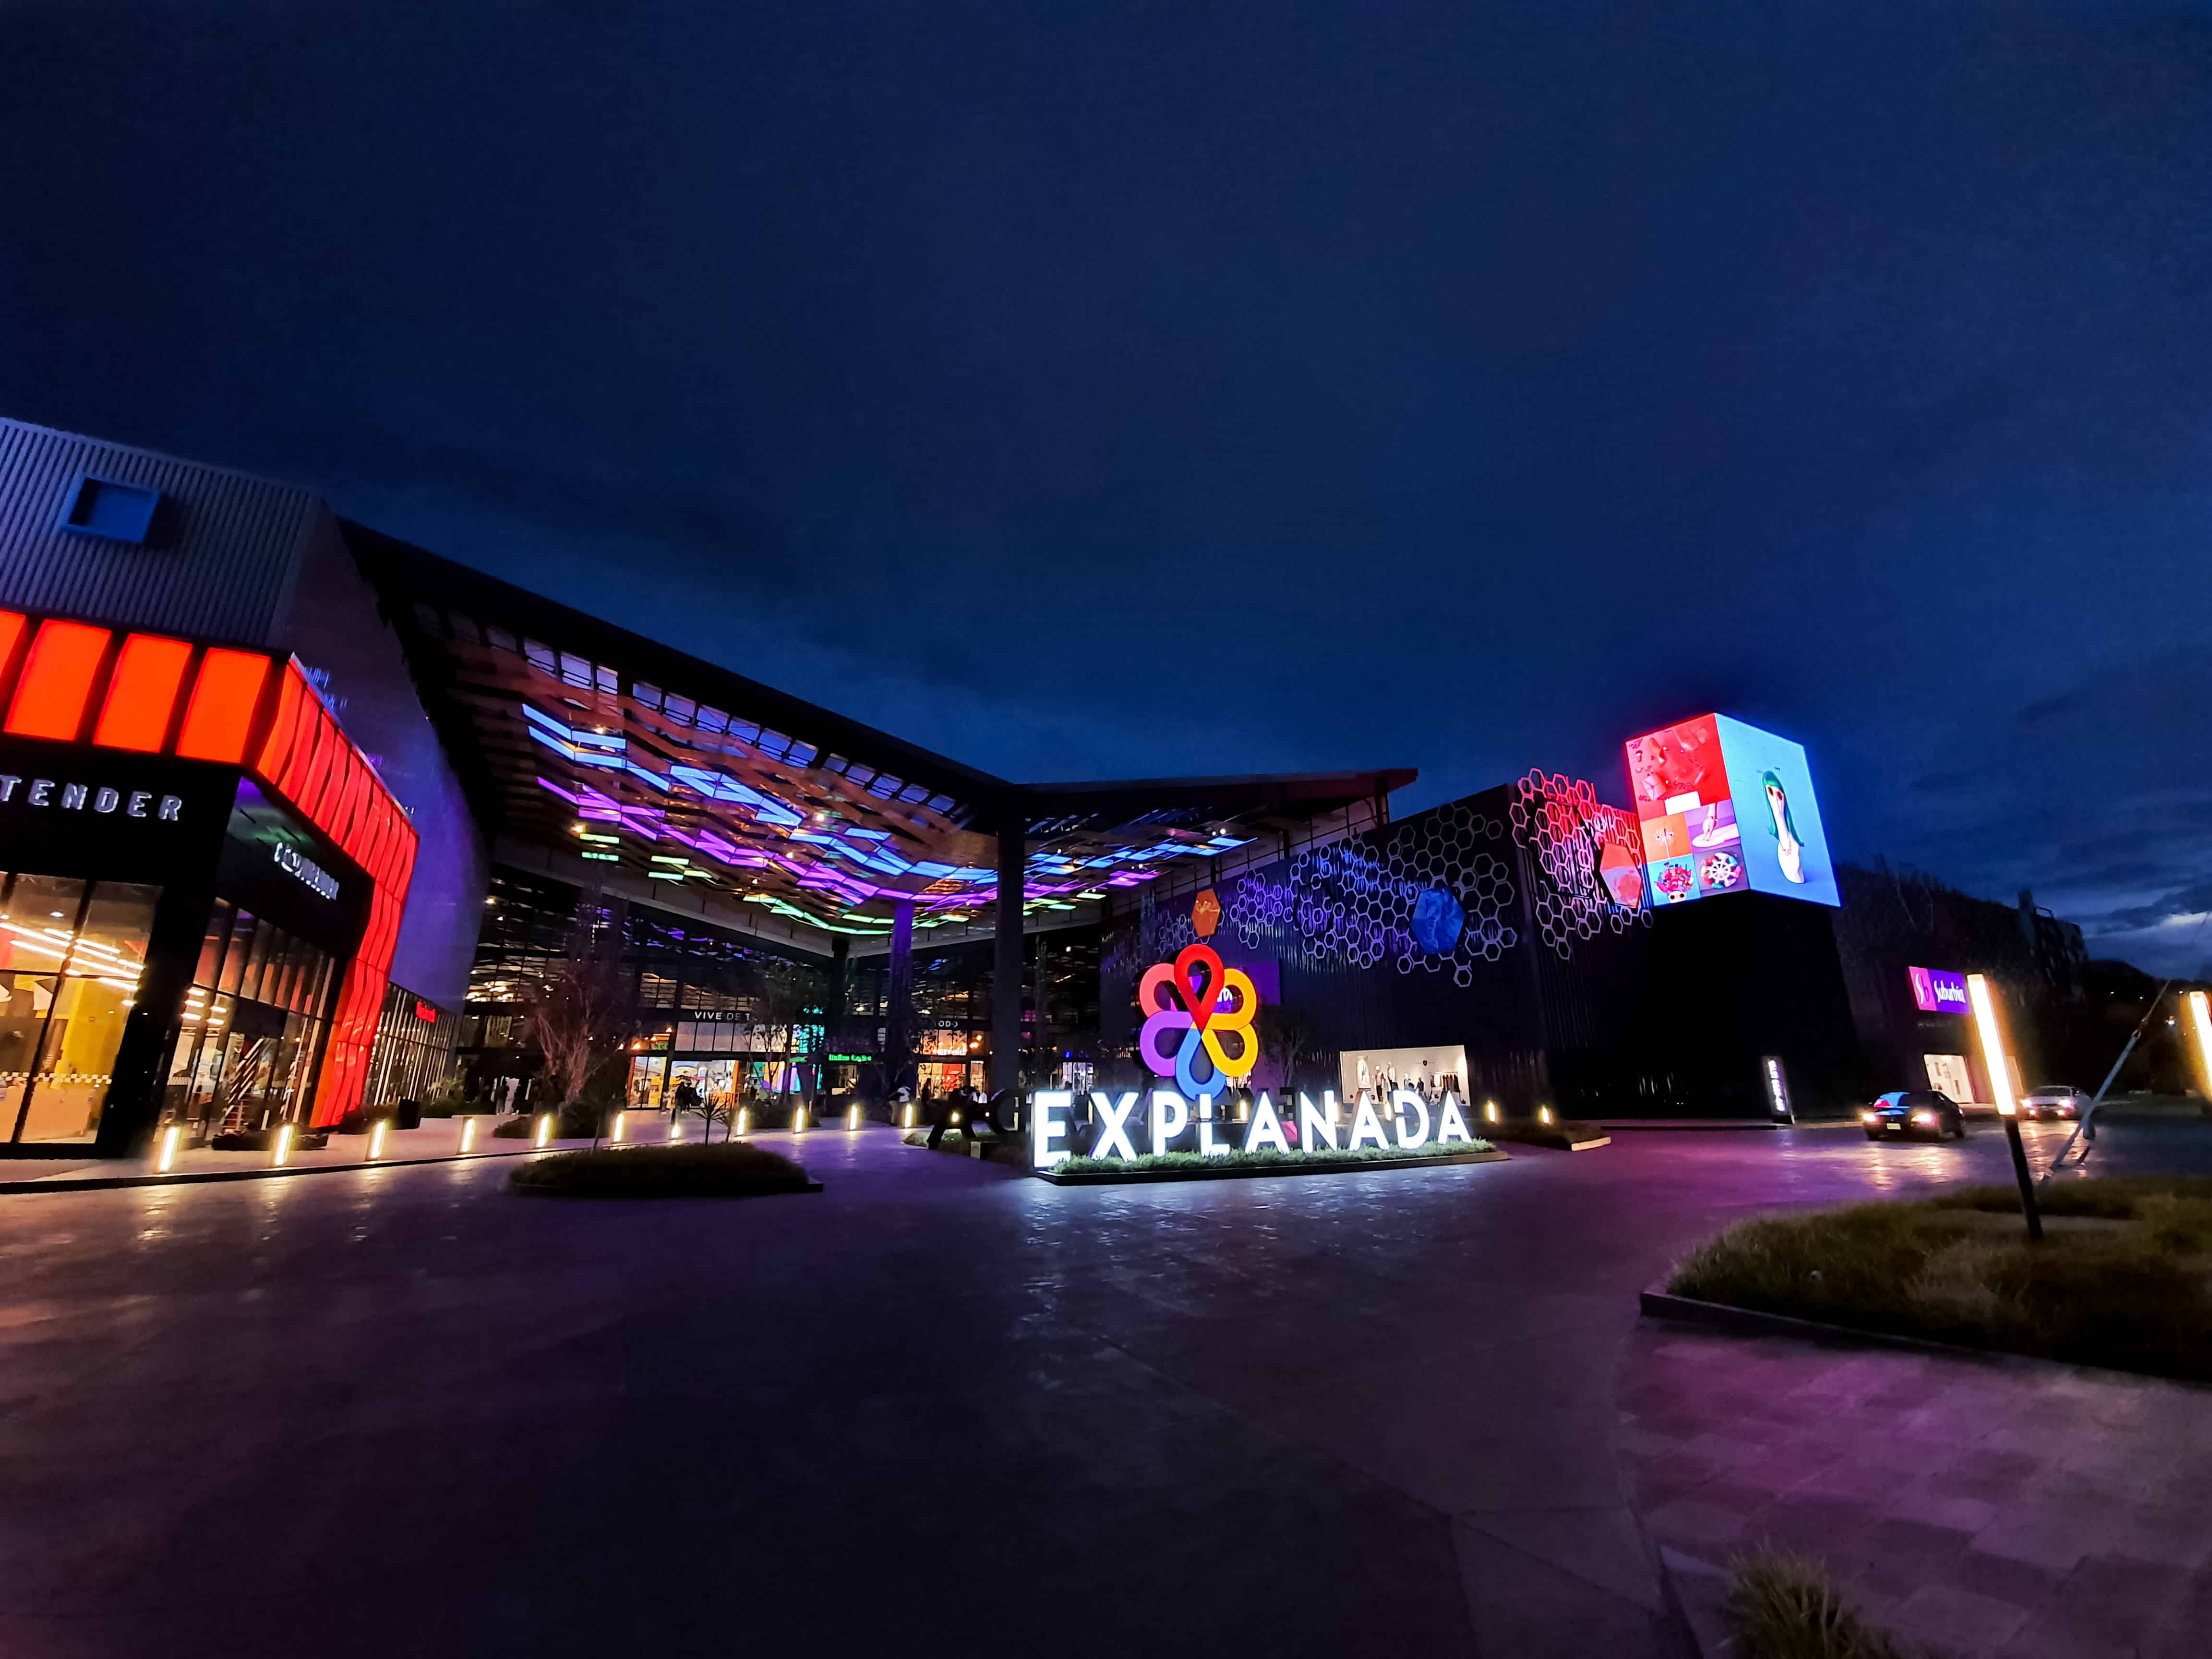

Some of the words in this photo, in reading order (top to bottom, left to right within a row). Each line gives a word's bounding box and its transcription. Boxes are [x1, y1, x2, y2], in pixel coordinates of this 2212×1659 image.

[0, 774, 182, 821] TENDER
[1934, 980, 1966, 1004] Suburbia
[695, 1011, 722, 1020] VIVE
[1034, 1090, 1472, 1168] EXPLANADA
